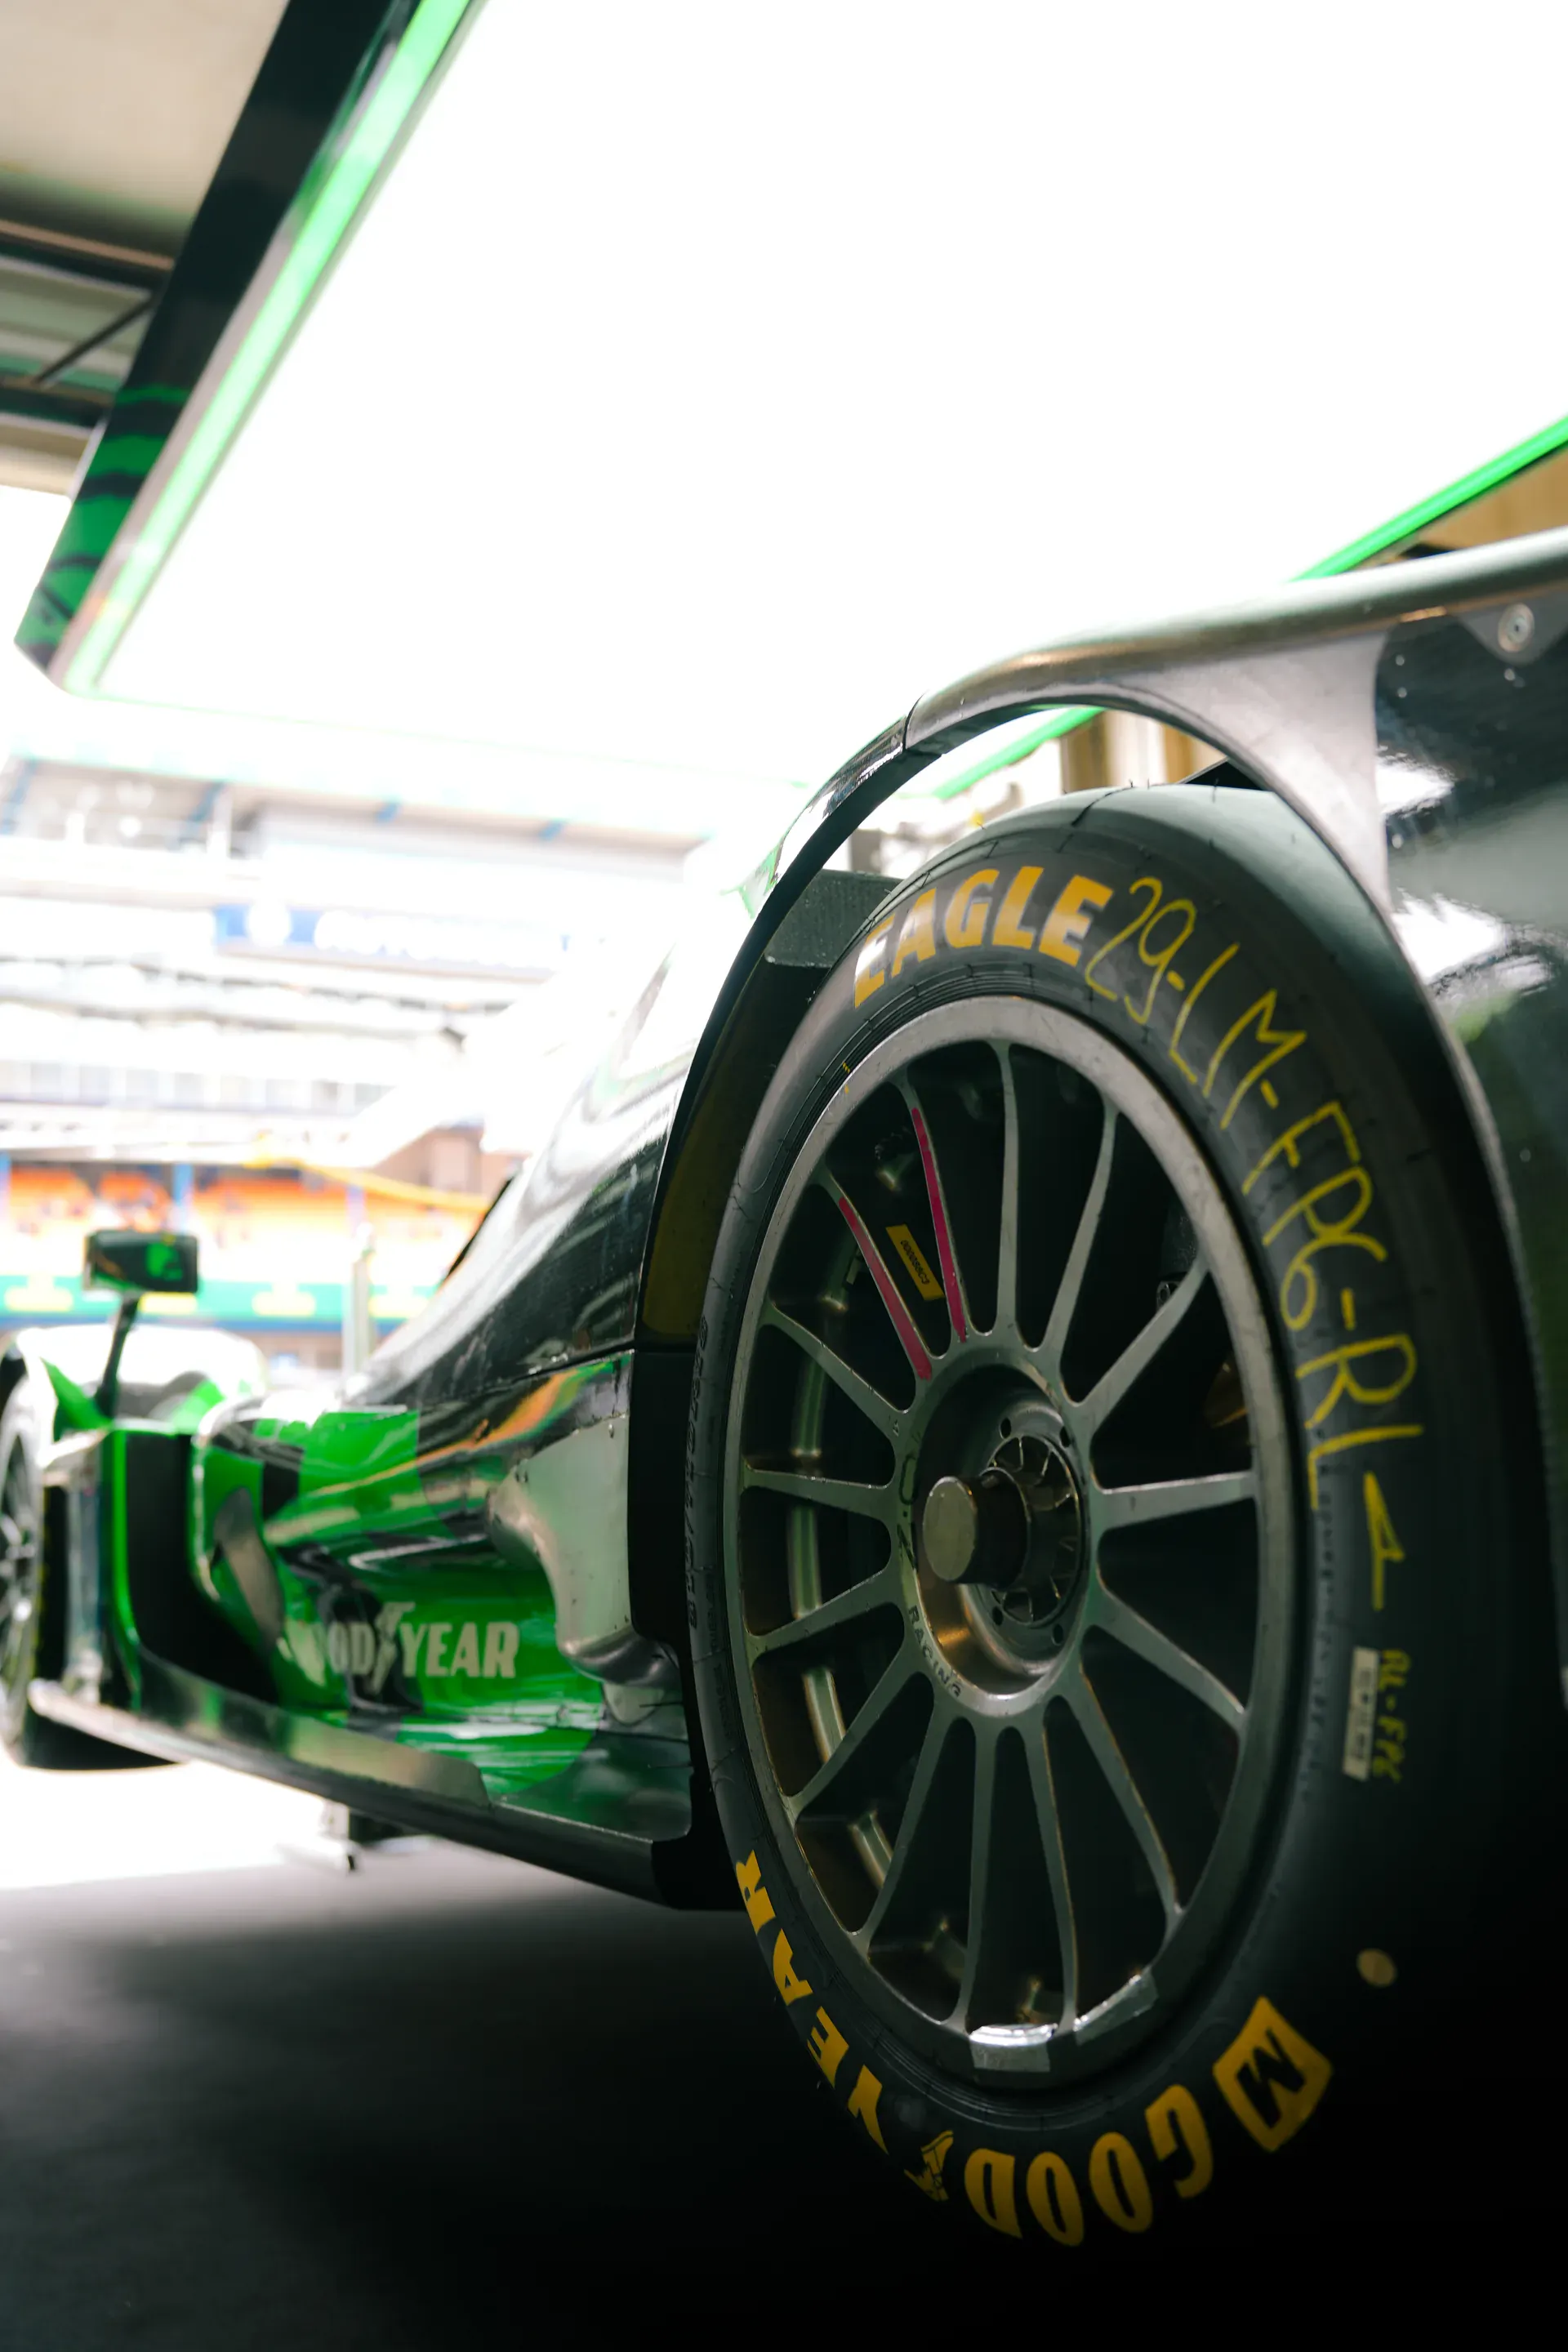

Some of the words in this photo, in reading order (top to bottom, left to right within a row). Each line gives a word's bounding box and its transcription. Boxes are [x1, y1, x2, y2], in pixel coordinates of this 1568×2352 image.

[854, 866, 1114, 1009] EAGLE
[908, 1606, 961, 1698] RACING
[1235, 2028, 1305, 2123] M
